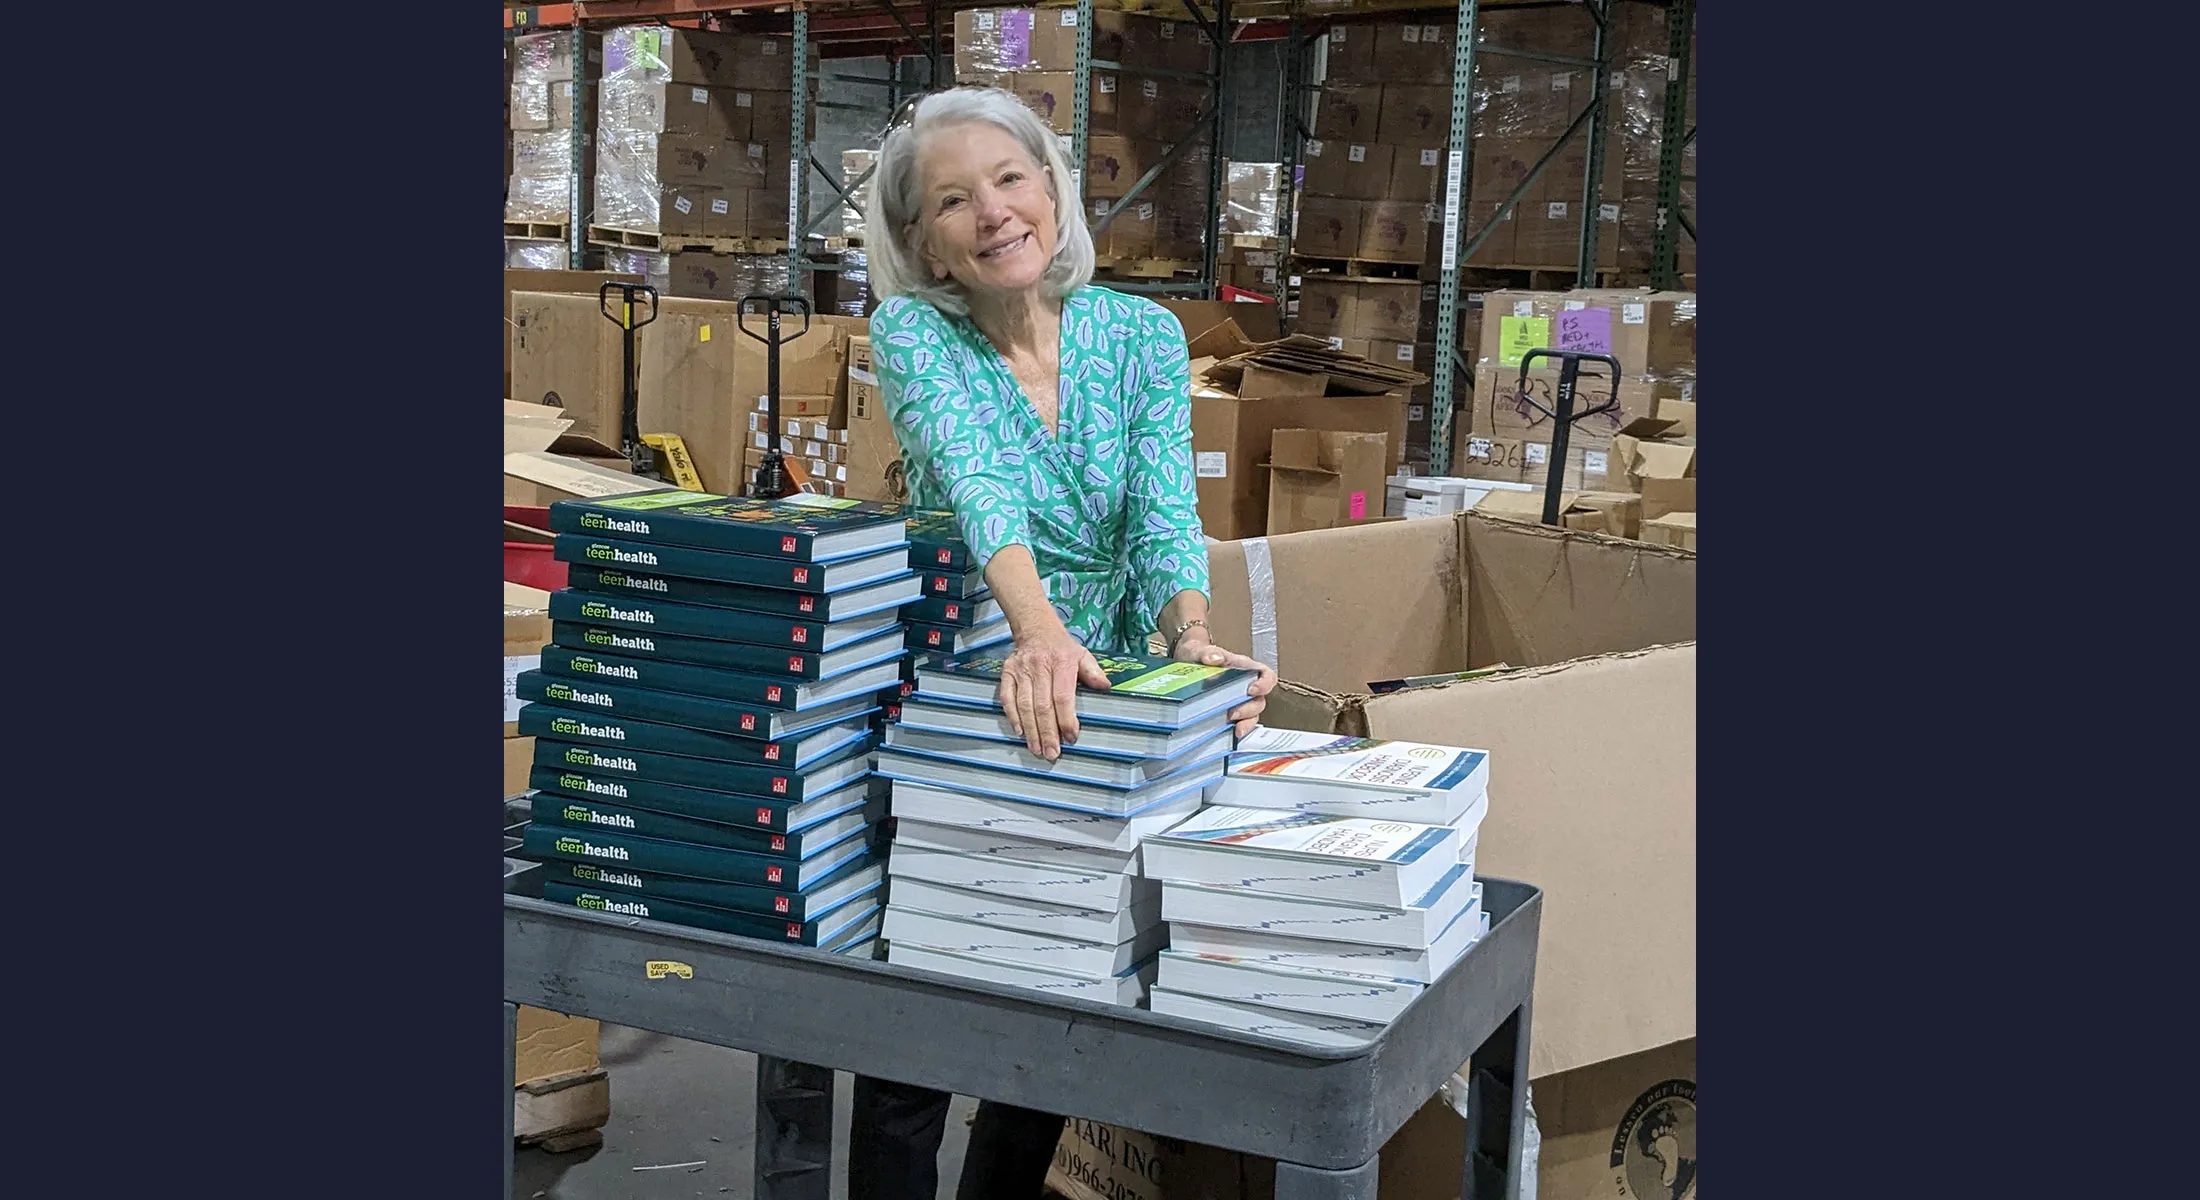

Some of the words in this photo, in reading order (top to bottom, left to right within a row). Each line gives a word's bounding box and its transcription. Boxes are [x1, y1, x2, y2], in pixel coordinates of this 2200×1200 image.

[580, 515, 650, 535] teenhealth
[585, 546, 658, 566] teenhealth
[599, 573, 668, 592] teenhealth
[581, 604, 655, 624] teenhealth
[583, 631, 655, 651] teenhealth
[570, 659, 639, 680] teenhealth
[545, 686, 613, 707] teenhealth
[551, 720, 625, 740] teenhealth
[565, 751, 637, 772] teenhealth
[560, 776, 628, 798] teenhealth
[563, 807, 635, 828] teenhealth
[555, 839, 629, 861] teenhealth
[572, 866, 643, 888] teenhealth
[576, 896, 649, 917] teenhealth
